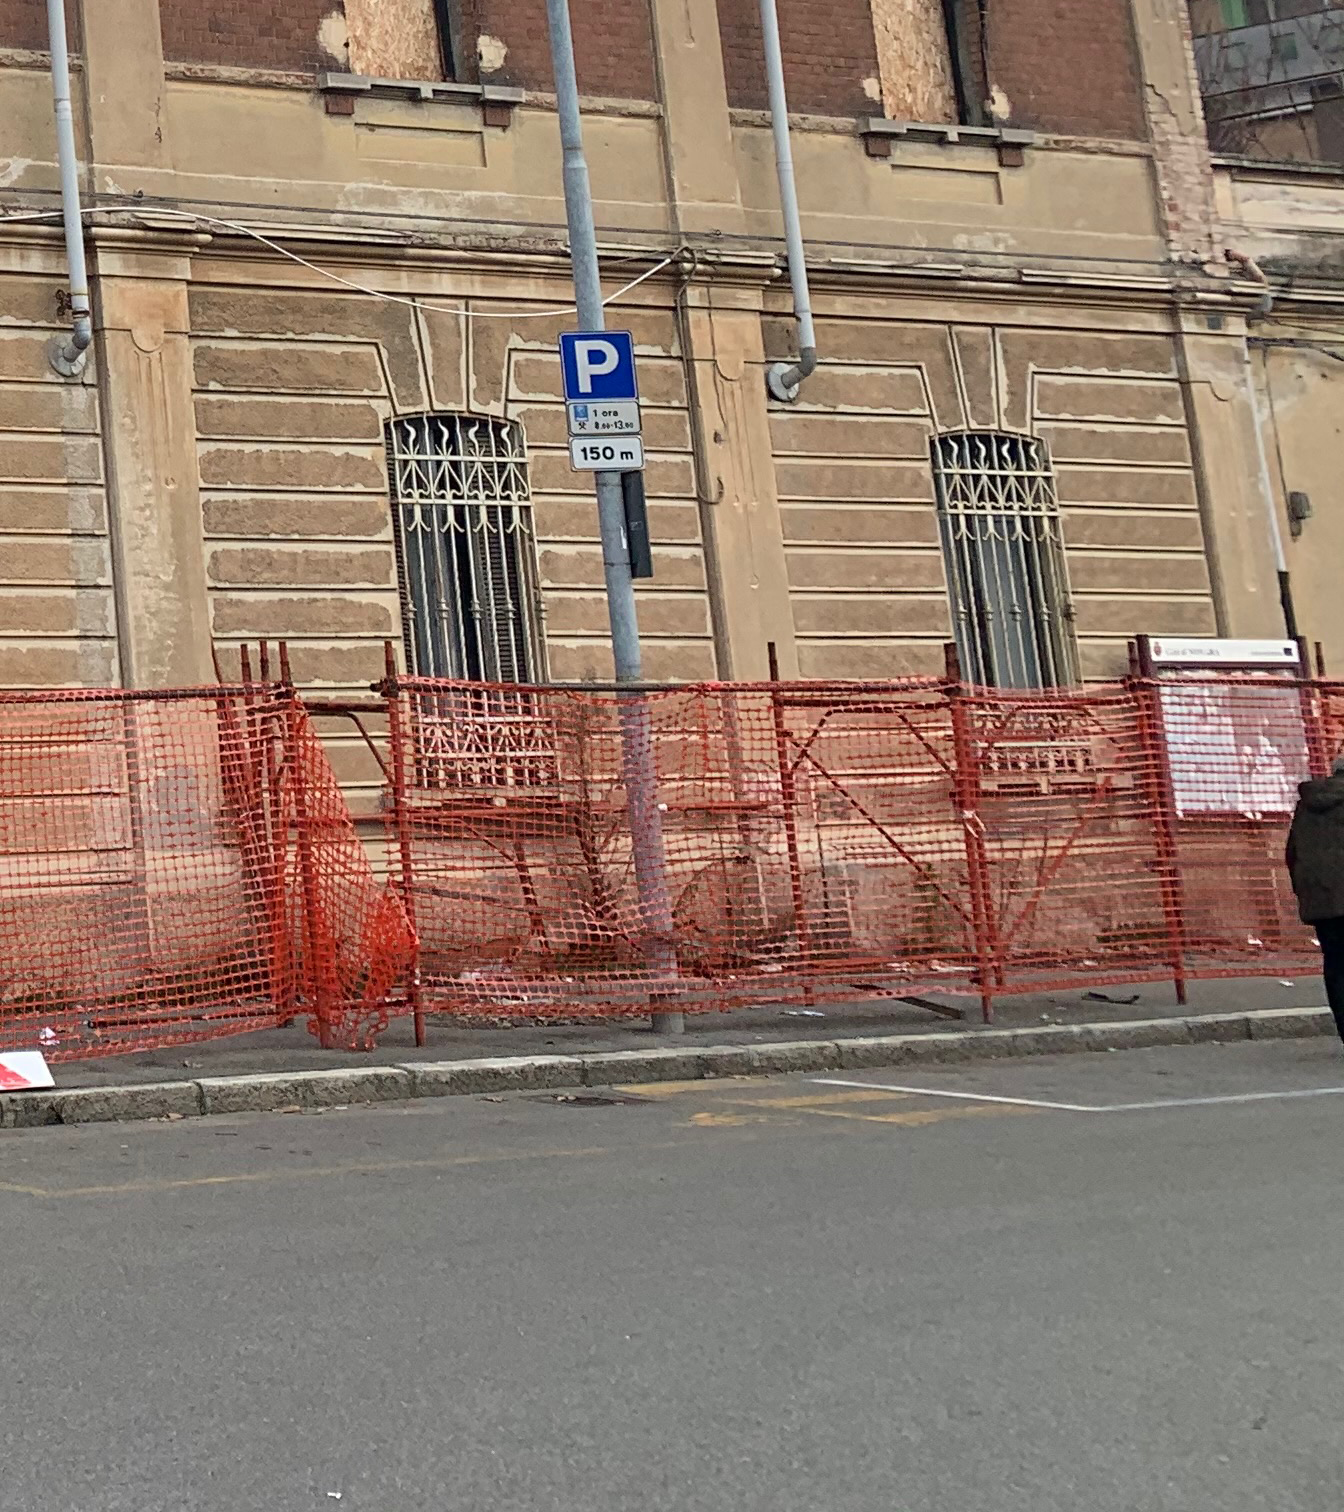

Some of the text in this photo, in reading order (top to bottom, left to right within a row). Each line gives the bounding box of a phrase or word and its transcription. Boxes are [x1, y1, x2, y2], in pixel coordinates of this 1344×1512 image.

[574, 339, 620, 394] P
[592, 409, 598, 417] 1
[580, 446, 634, 461] 150 m
